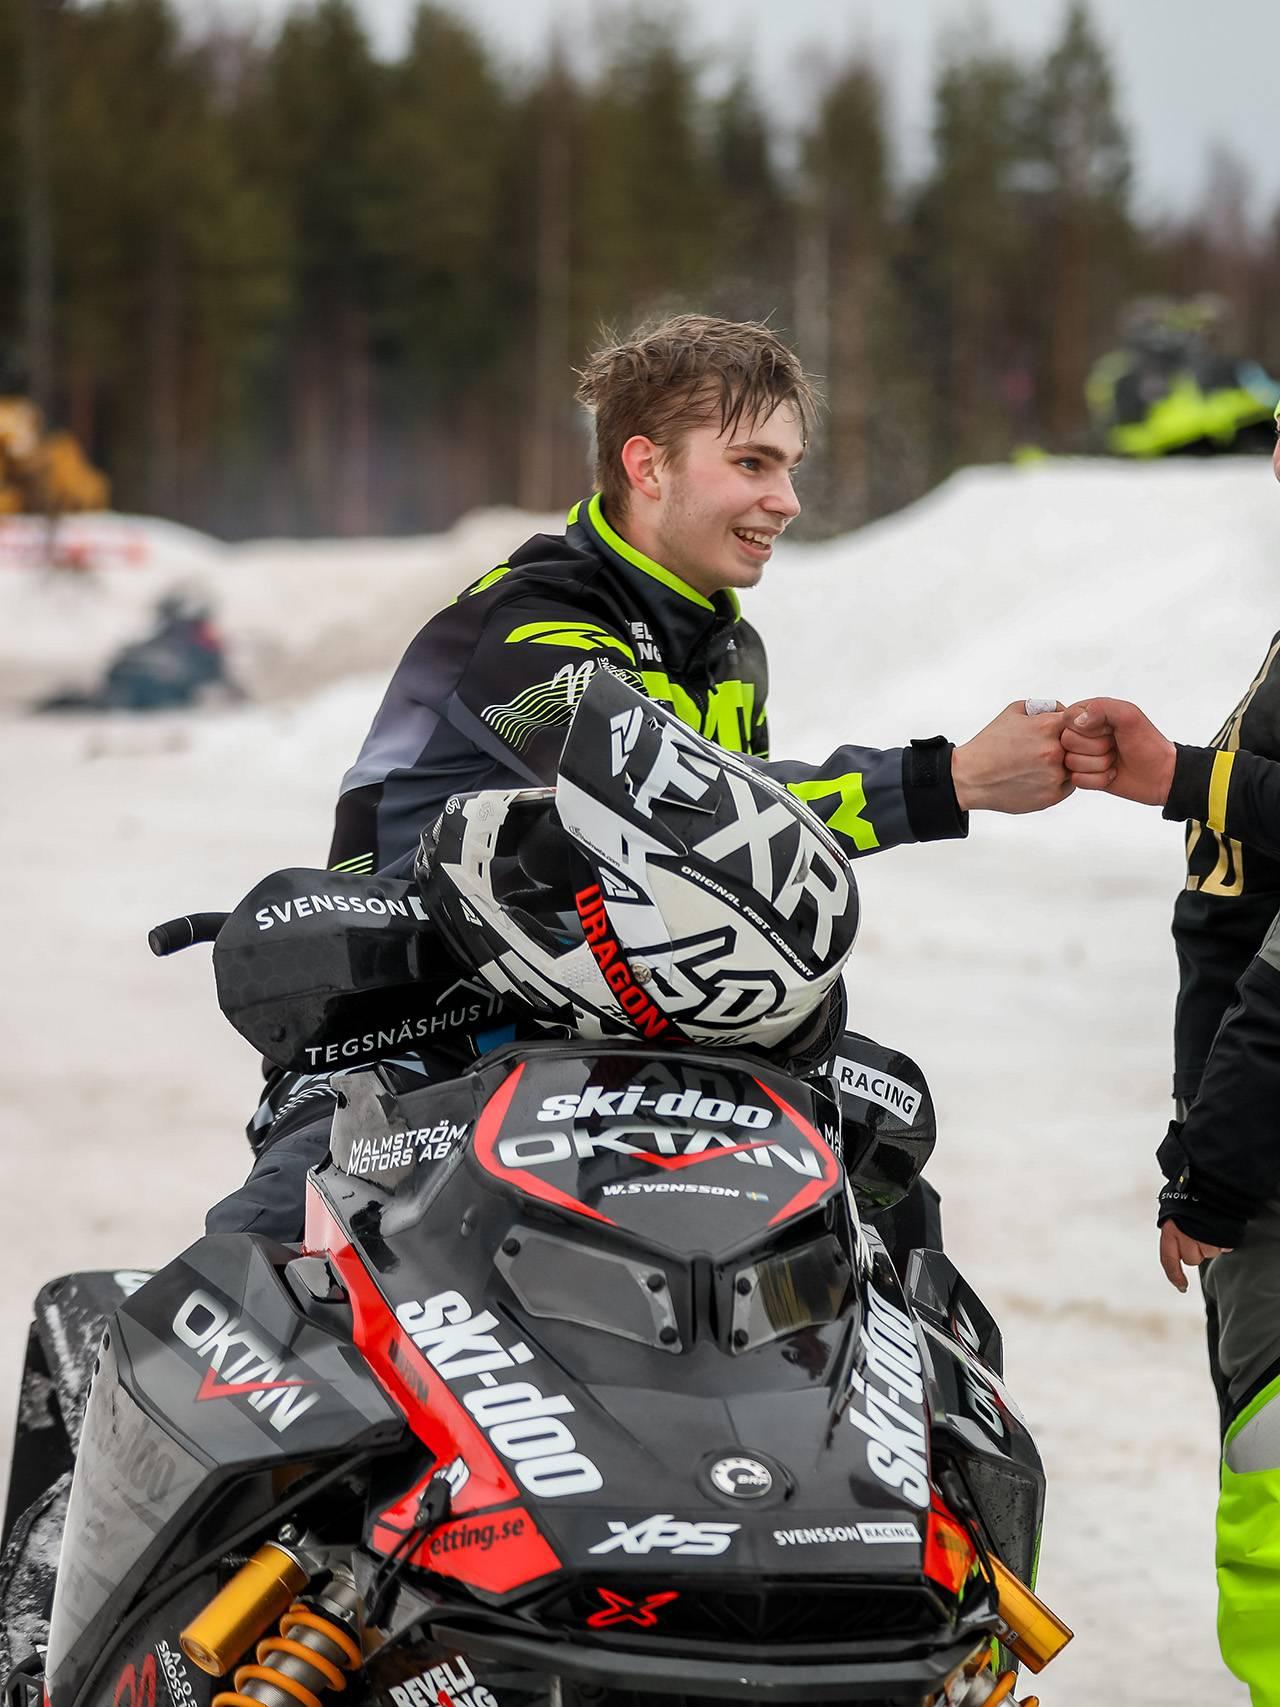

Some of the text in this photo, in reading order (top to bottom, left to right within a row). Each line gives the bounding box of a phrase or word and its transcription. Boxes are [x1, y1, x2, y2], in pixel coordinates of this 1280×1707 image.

[255, 895, 407, 931] SVENSSON
[680, 865, 815, 978] ORIGINAL FAST COMPANY
[575, 883, 669, 1038] DRAGON
[304, 1003, 482, 1067] TEGSNÄSHUS
[536, 1085, 773, 1129] ski-doo
[839, 1065, 916, 1115] RACING
[418, 1141, 452, 1162] AB
[498, 1125, 824, 1179] OKTAN
[1161, 1192, 1189, 1200] SNOW
[171, 1288, 320, 1432] OKTAN
[396, 1289, 603, 1499] ski-doo
[850, 1280, 930, 1509] ski-doo
[430, 1519, 525, 1556] etting.se
[588, 1514, 742, 1556] XPS
[773, 1525, 915, 1546] SVENSSON RACING
